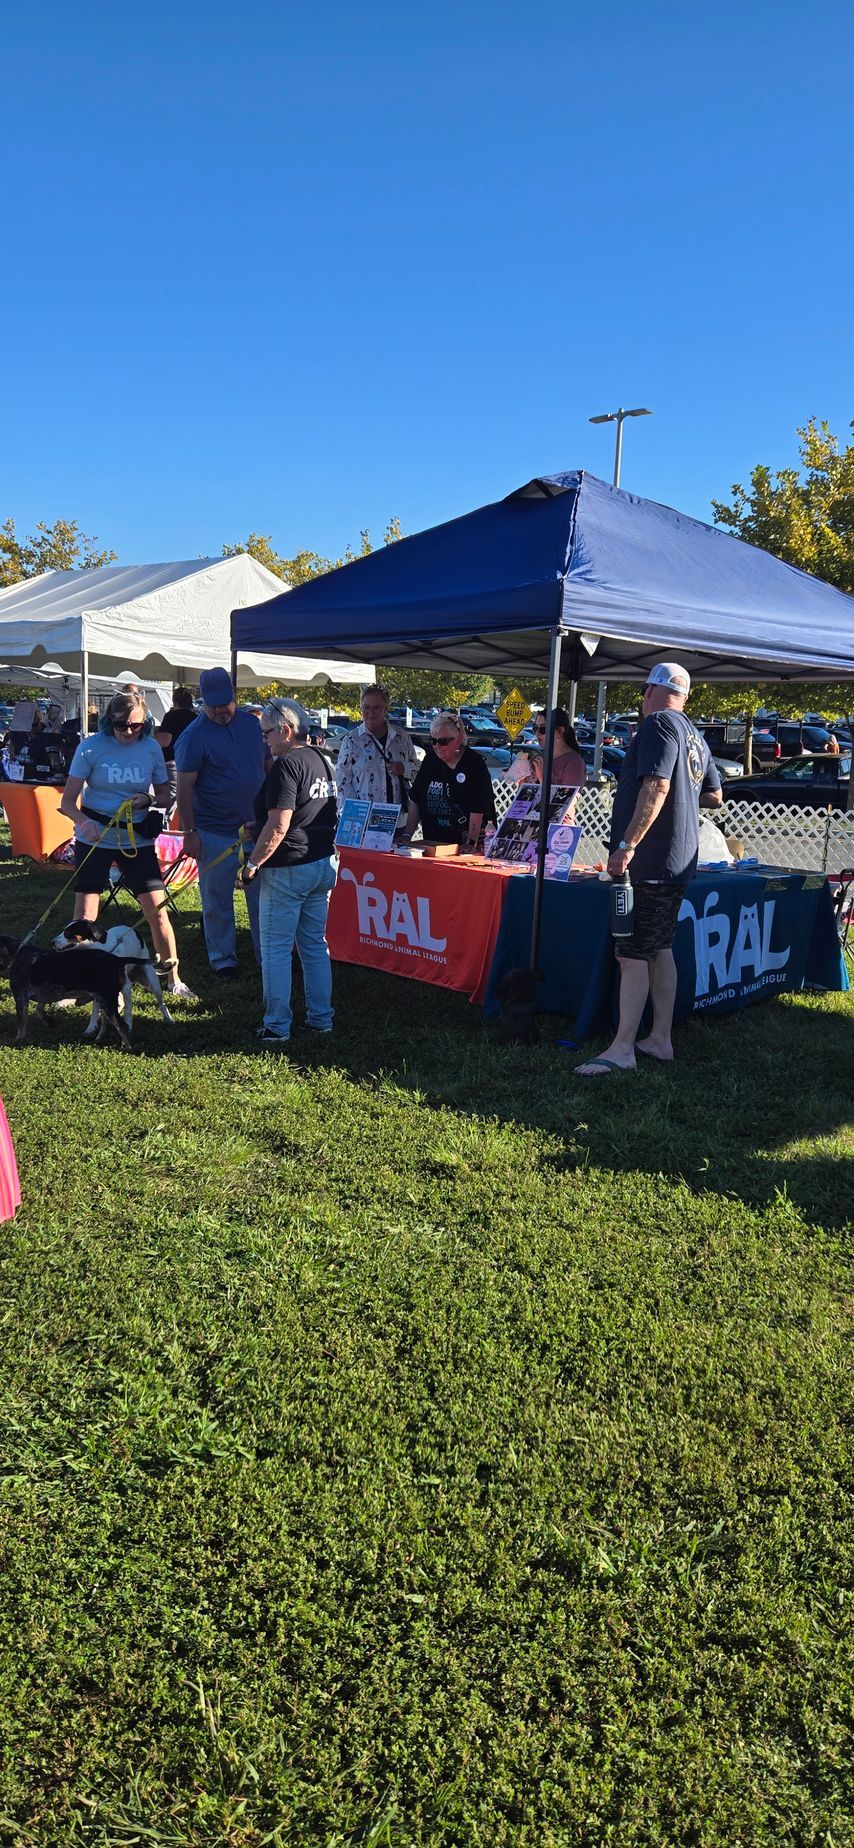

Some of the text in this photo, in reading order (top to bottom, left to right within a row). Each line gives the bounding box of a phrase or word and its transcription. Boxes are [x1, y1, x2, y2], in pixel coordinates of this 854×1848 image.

[505, 700, 526, 710] SPEED
[504, 718, 525, 726] AHEAD
[104, 764, 146, 783] RAL
[342, 868, 447, 952] RAL
[617, 892, 625, 913] YETI
[359, 936, 448, 964] RICHMOND ANIMAL LEAGUE
[678, 891, 791, 997] RAL
[693, 988, 736, 1010] RICHMOND
